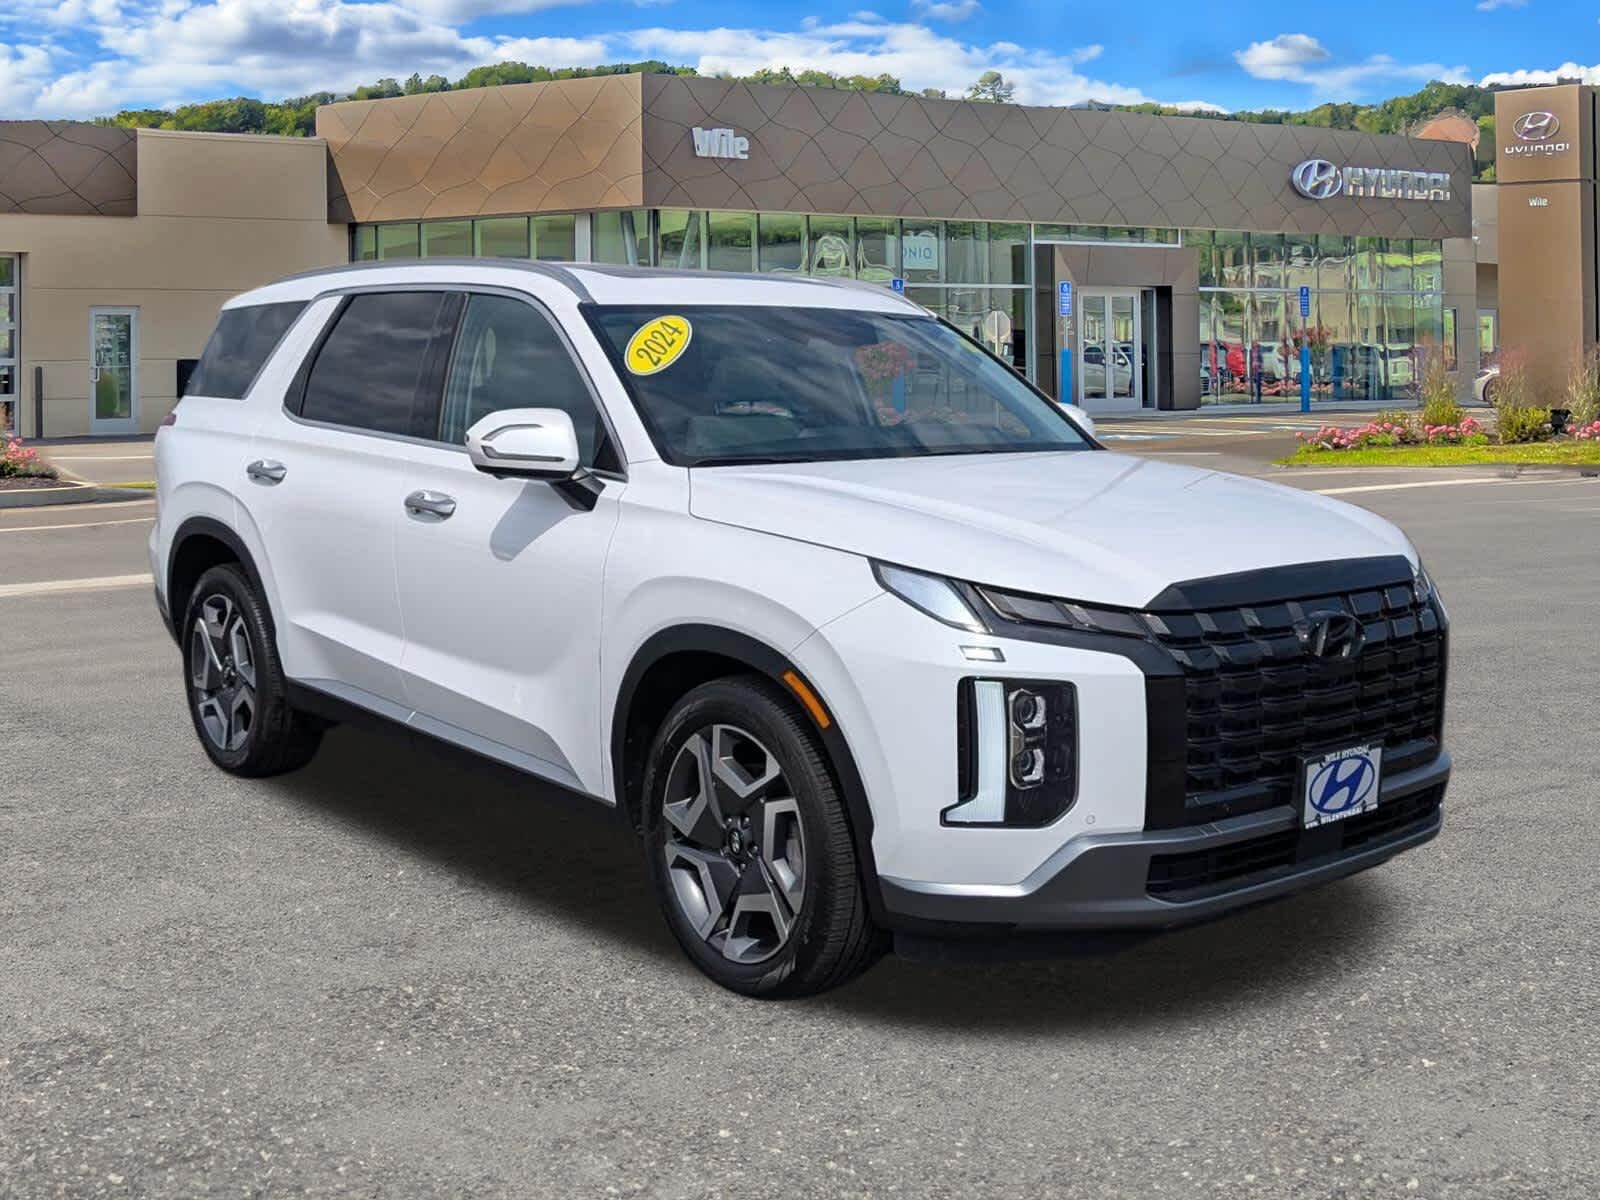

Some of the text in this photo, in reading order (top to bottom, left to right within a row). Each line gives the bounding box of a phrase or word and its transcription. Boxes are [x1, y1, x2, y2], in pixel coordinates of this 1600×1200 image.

[692, 127, 749, 160] Wile
[1343, 166, 1450, 201] HYUNDAI
[1528, 197, 1549, 207] Wile
[636, 320, 683, 367] 2024
